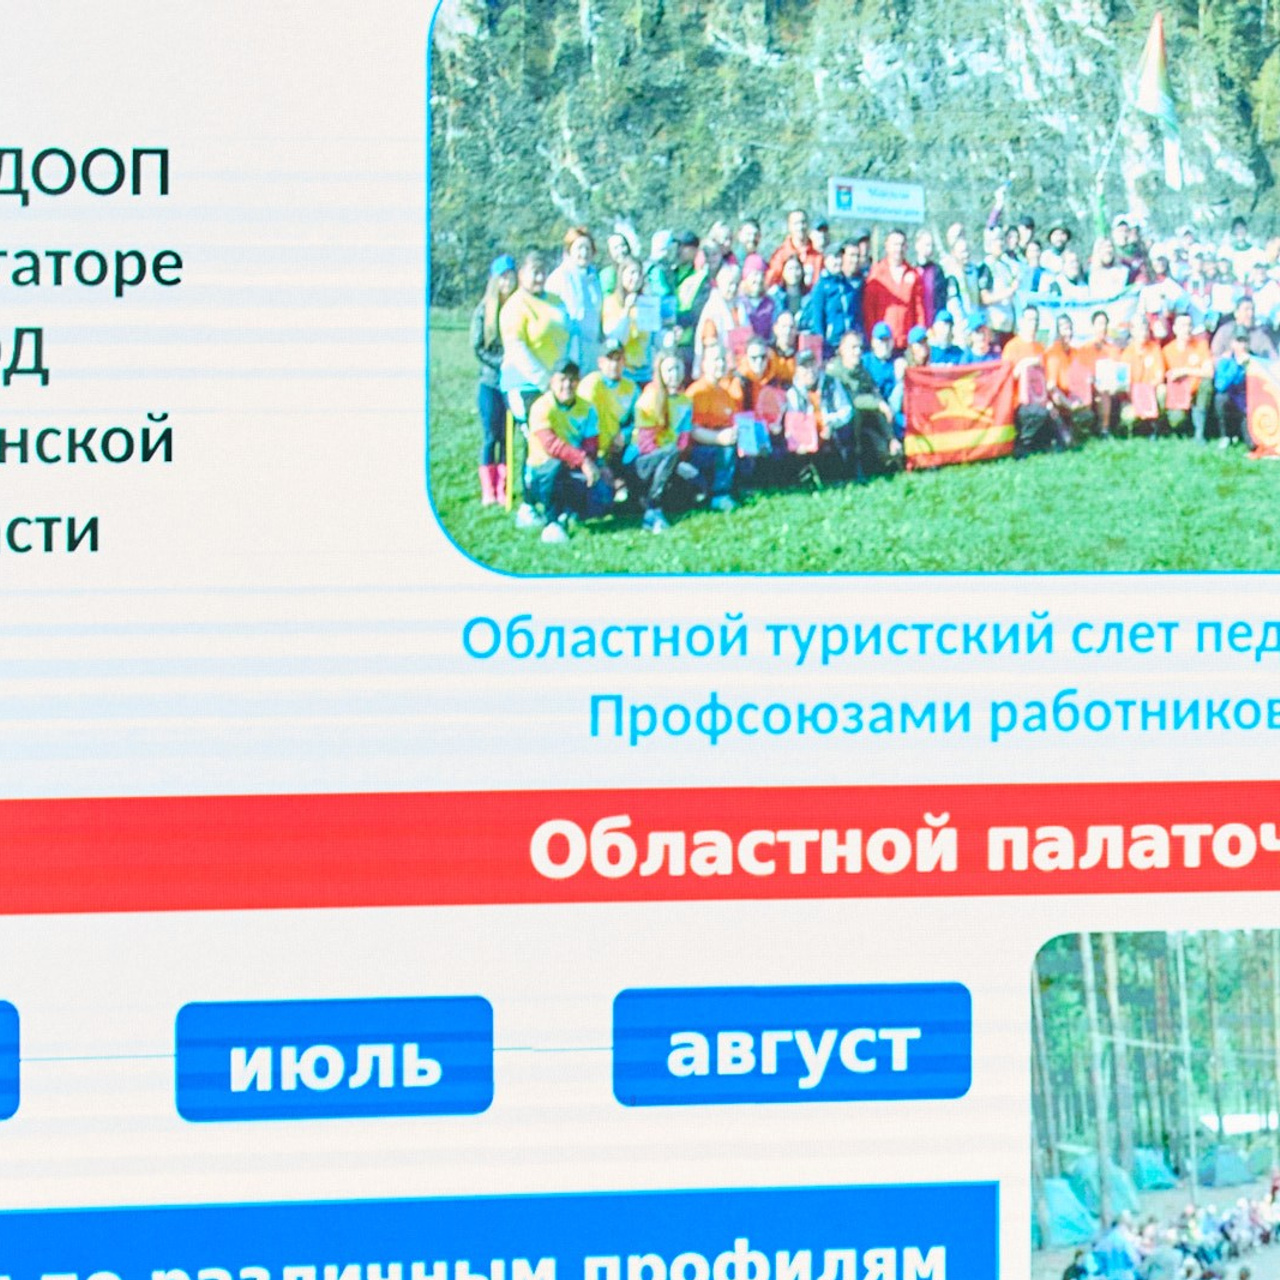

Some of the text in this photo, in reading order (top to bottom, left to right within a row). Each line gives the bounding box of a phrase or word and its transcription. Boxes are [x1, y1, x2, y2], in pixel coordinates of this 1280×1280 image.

[0, 248, 184, 298] аторе
[0, 326, 50, 388] Д
[5, 515, 100, 554] сти
[461, 611, 748, 660] Областной
[765, 610, 1054, 667] туристский
[1071, 620, 1180, 655] слет
[589, 690, 971, 748] Профсоюзами
[529, 811, 959, 880] Областной
[230, 1042, 442, 1092] июль
[666, 1025, 922, 1090] август
